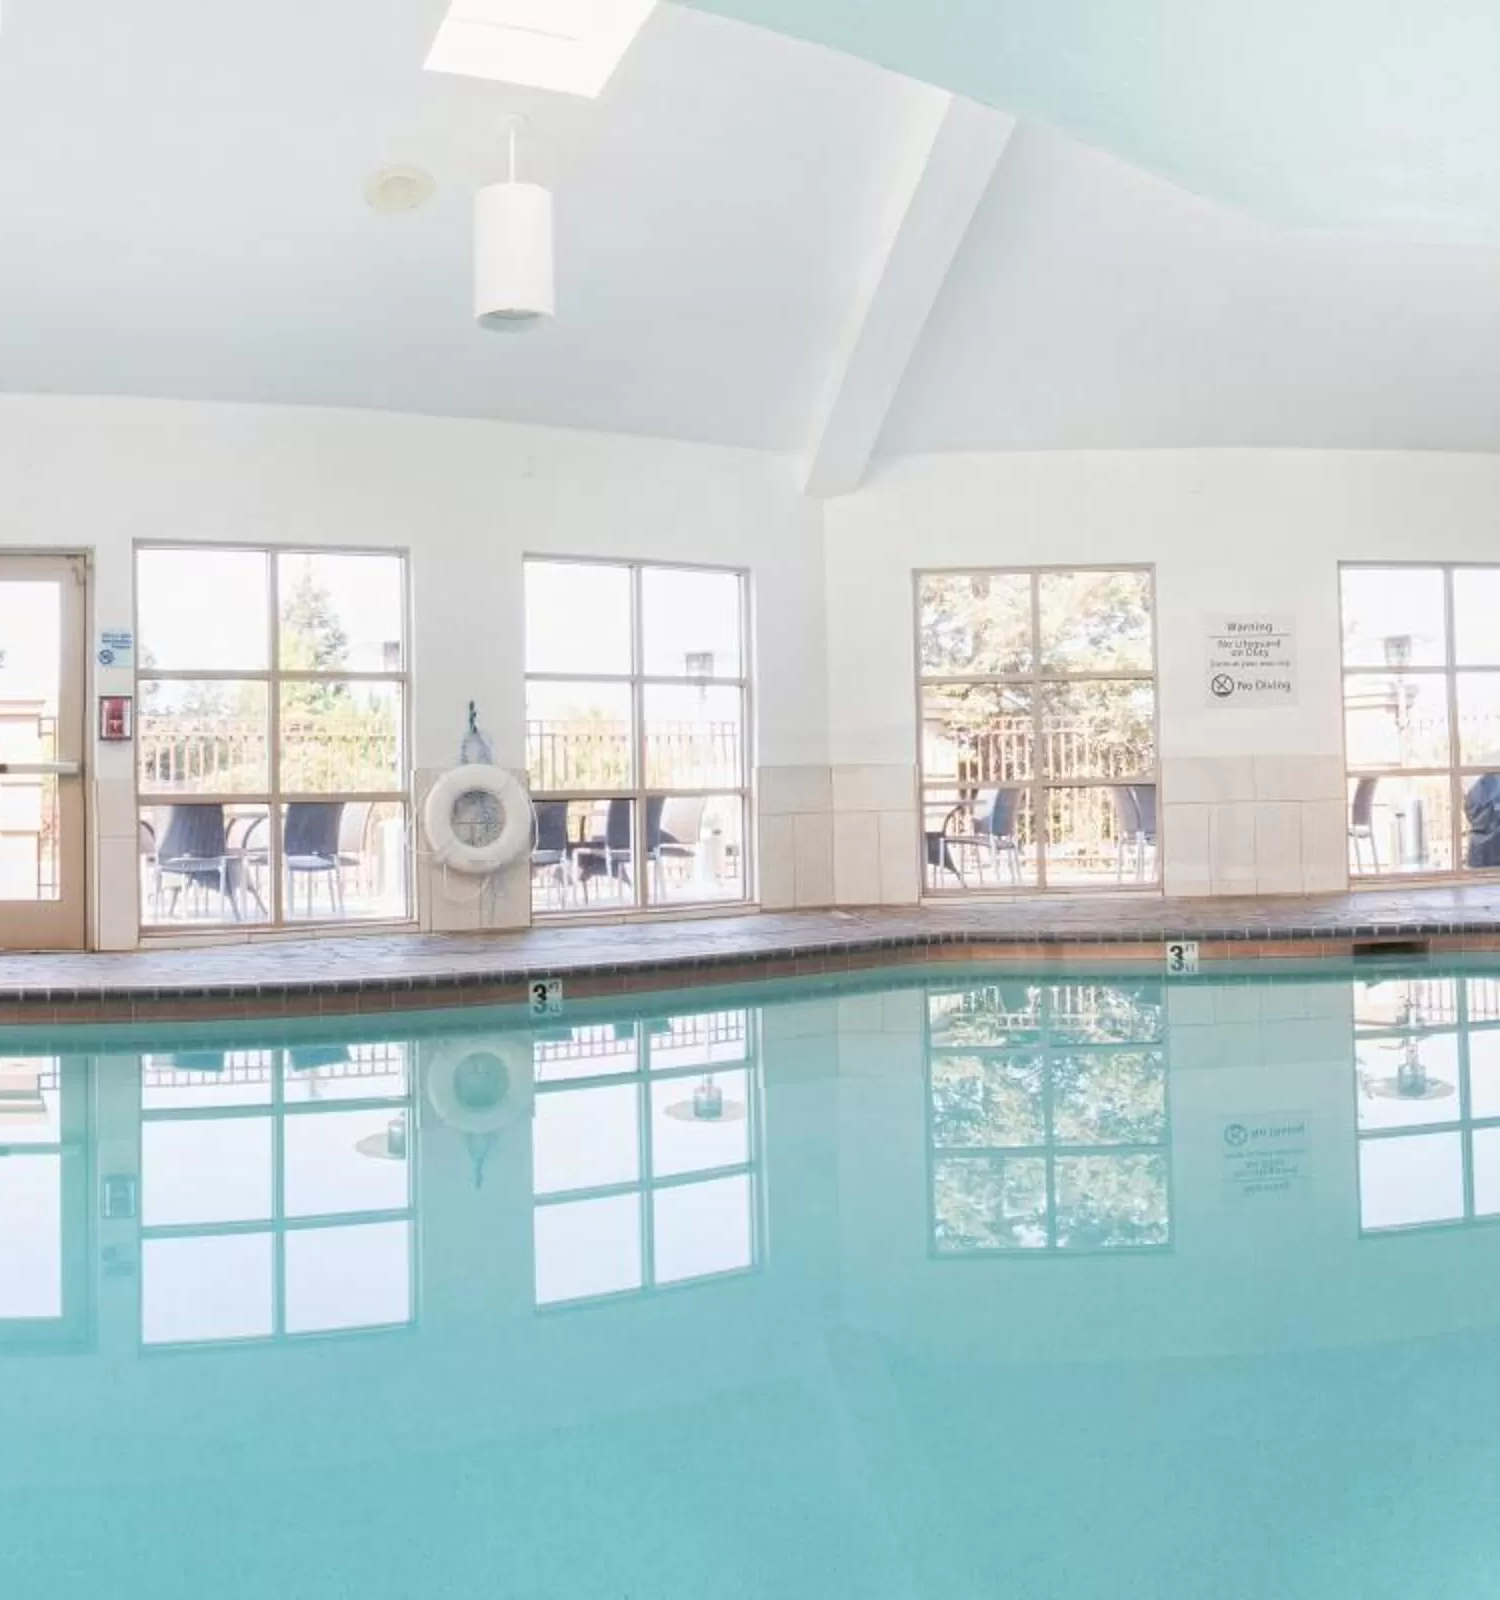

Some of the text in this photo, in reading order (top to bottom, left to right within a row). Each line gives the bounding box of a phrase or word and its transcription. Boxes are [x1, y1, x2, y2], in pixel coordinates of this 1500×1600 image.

[1227, 622, 1273, 634] Warning
[1217, 639, 1232, 648] No
[1237, 680, 1291, 692] No Diving
[1170, 945, 1183, 960] 3
[533, 983, 547, 1000] 3
